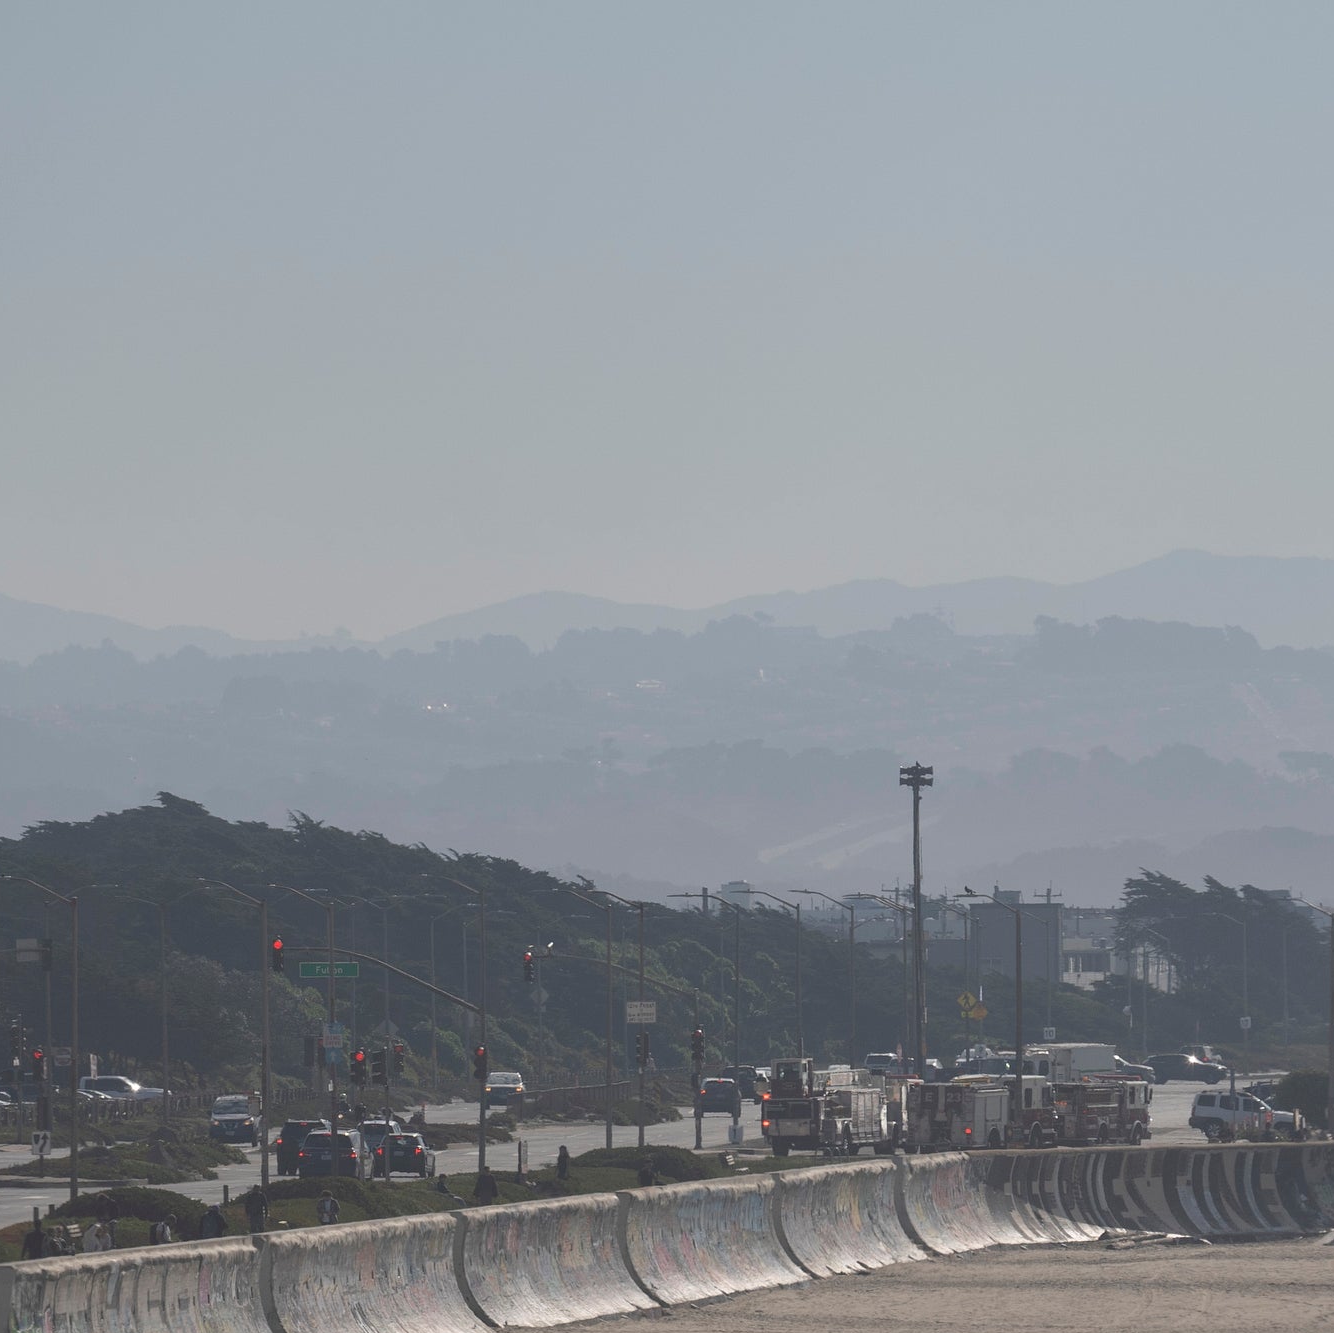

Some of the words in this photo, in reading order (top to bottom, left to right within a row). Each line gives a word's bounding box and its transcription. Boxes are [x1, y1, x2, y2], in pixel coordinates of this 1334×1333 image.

[315, 966, 343, 974] Fulon
[925, 1092, 933, 1102] E
[947, 1092, 962, 1102] 23
